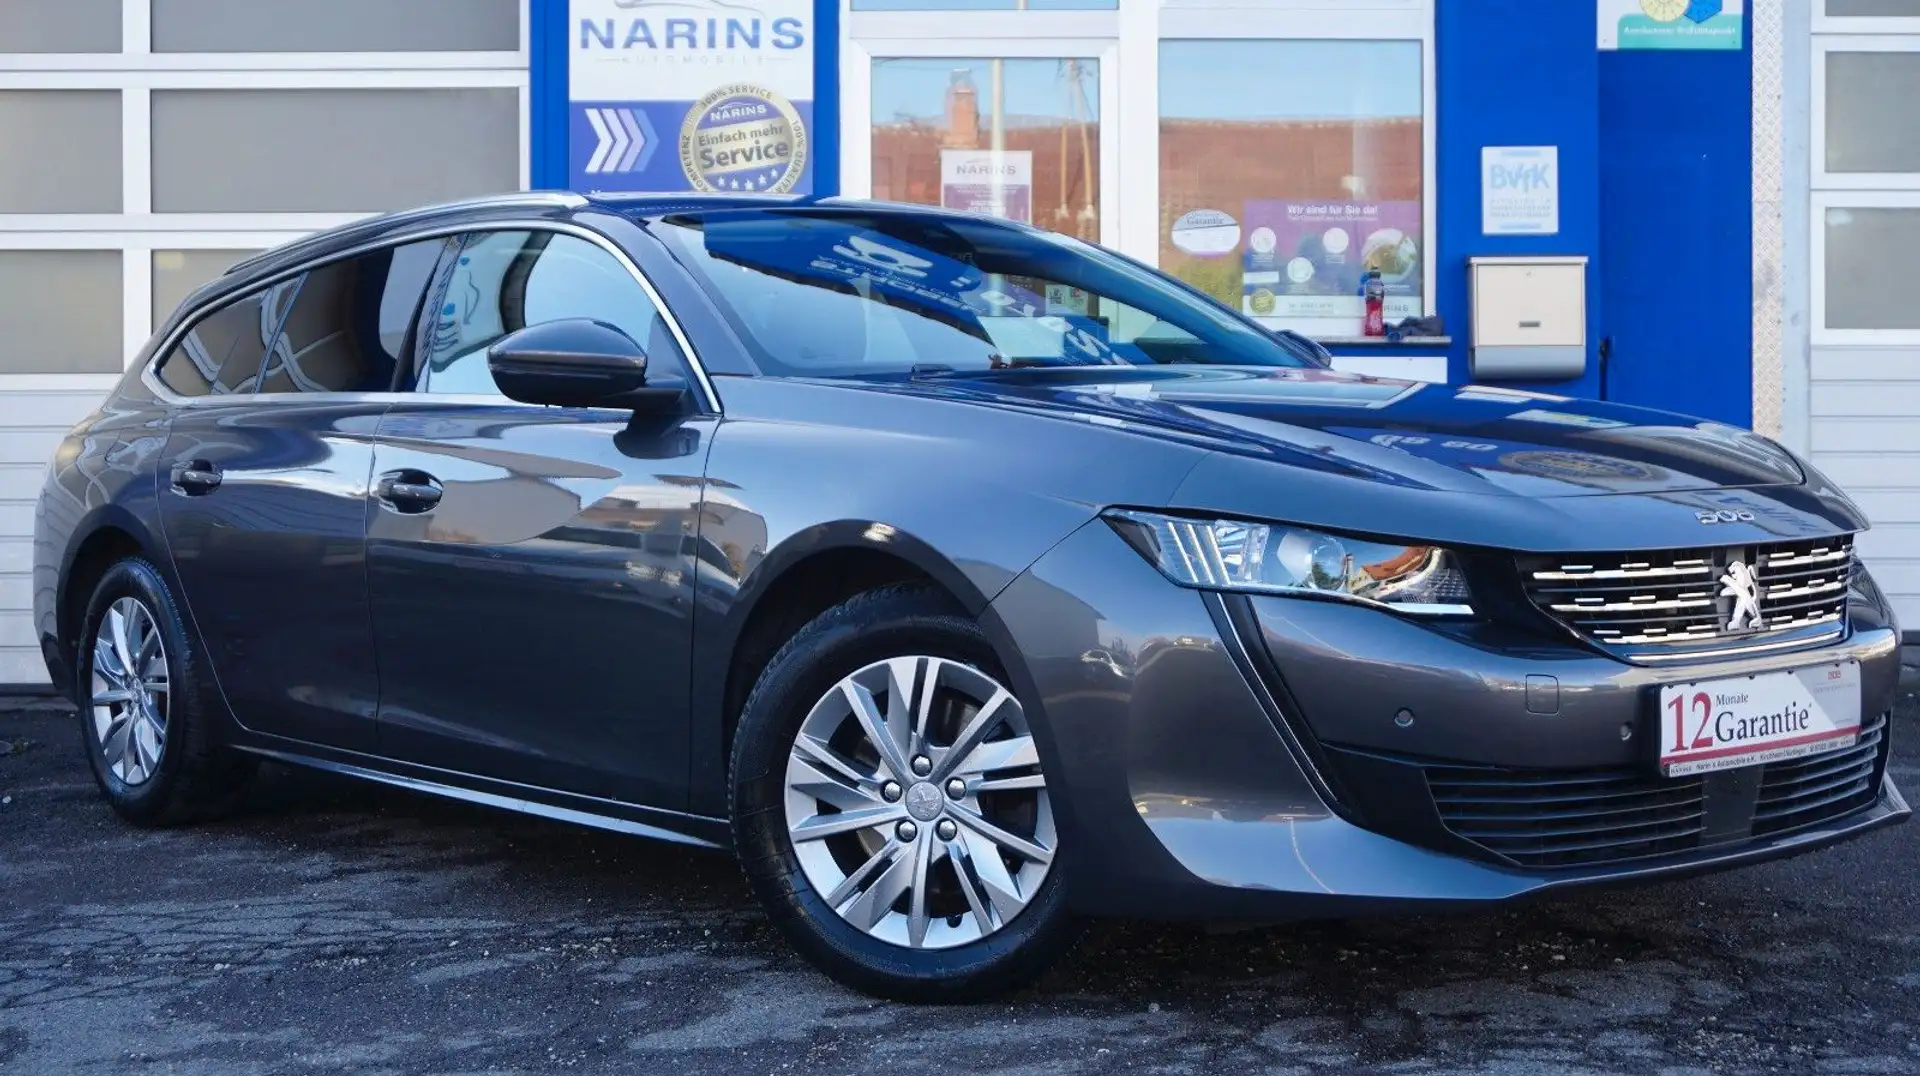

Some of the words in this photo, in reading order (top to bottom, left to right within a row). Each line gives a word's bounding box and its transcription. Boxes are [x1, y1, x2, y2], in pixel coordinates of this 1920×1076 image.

[580, 17, 804, 49] NARINS
[728, 84, 773, 99] SERVICE
[710, 104, 767, 121] NARINS
[698, 129, 747, 147] Einfach
[750, 123, 784, 138] mehr
[700, 139, 790, 170] Service
[956, 164, 1016, 174] NARINS
[1667, 692, 1713, 752] 12
[1715, 693, 1749, 707] Monate
